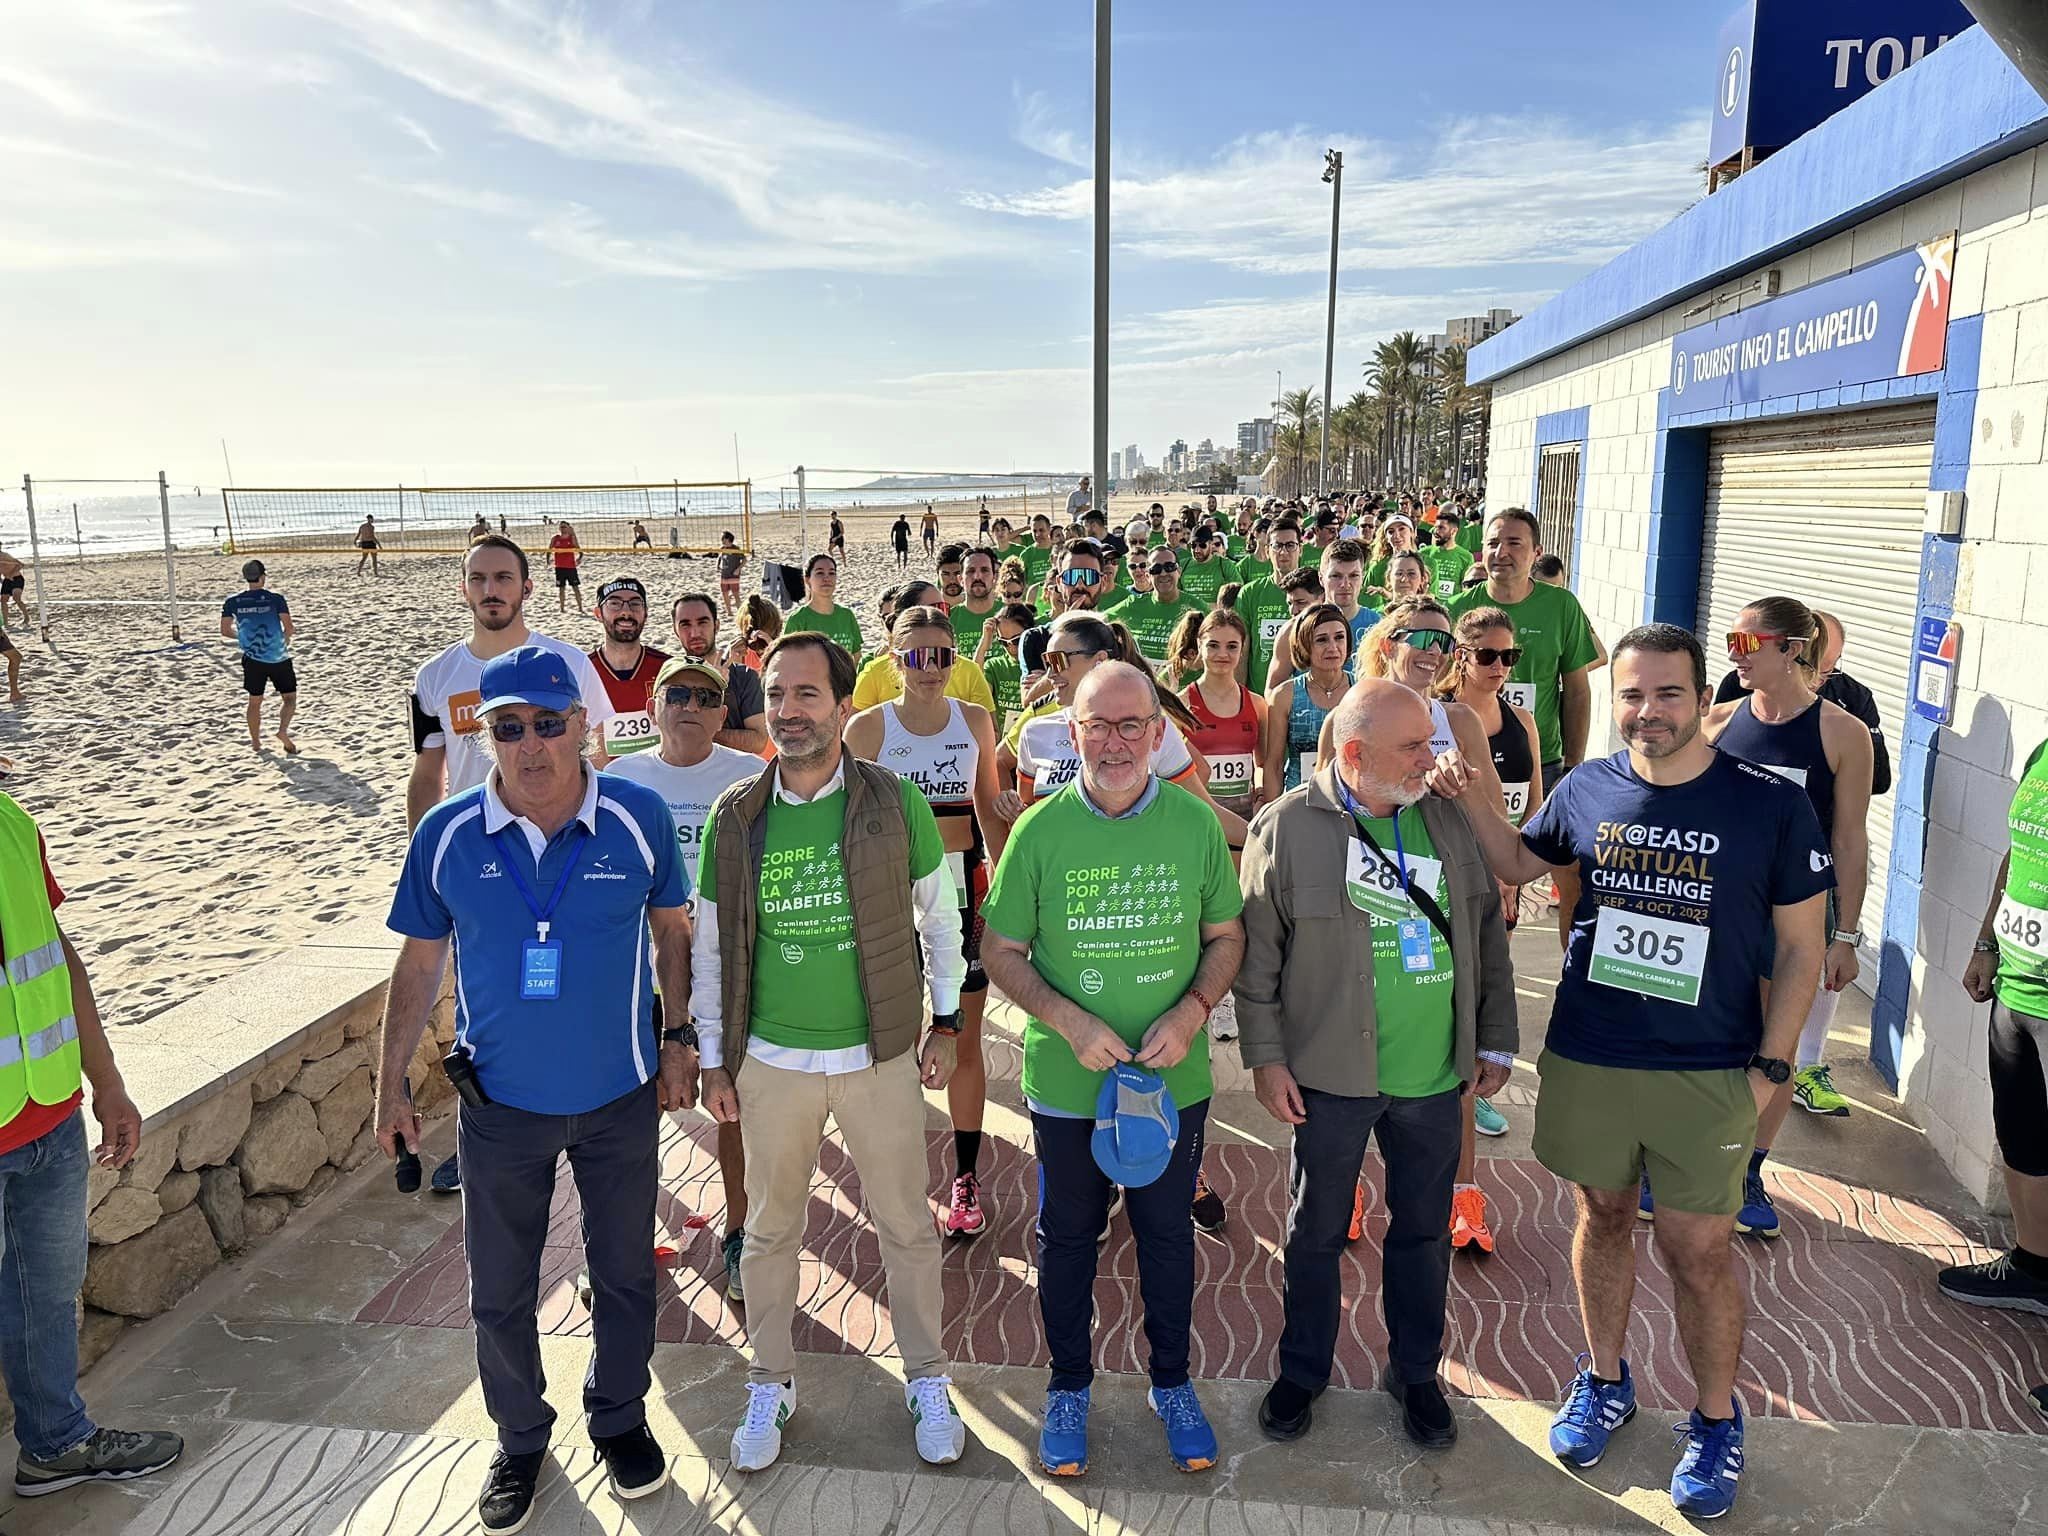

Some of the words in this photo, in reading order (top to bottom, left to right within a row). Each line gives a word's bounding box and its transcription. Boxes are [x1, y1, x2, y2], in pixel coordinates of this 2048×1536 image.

[1693, 342, 1738, 383] TOURIST
[1740, 332, 1772, 371] INFO
[1776, 327, 1791, 363] EL
[1794, 300, 1878, 358] CAMPELLO
[603, 581, 638, 596] INVICTUS
[614, 718, 651, 737] 239
[1213, 762, 1245, 779] 193
[1737, 763, 1773, 780] CRAFT
[1596, 822, 1720, 855] 5K@EASD
[761, 846, 815, 867] CORRE
[1594, 844, 1714, 882] VIRTUAL
[760, 867, 794, 884] POR
[1065, 866, 1120, 883] CORRE
[761, 885, 781, 899] LA
[1066, 884, 1100, 899] POR
[1591, 869, 1713, 901] CHALLENGE
[764, 891, 843, 914] DIABETES
[1066, 901, 1086, 915] LA
[1604, 896, 1626, 908] SEP
[1636, 901, 1645, 911] 4
[1647, 902, 1676, 917] OCT,
[1680, 906, 1709, 921] 2023
[777, 919, 819, 928] Caminata
[790, 926, 822, 936] Mundial
[838, 923, 848, 931] la
[1067, 915, 1144, 931] DIABETES
[2001, 908, 2042, 948] 348
[1077, 941, 1120, 949] Caminata
[1130, 938, 1164, 948] Carrera
[1613, 925, 1686, 966] 305
[1088, 950, 1122, 959] Mundial
[1125, 949, 1135, 958] de
[1137, 949, 1146, 957] la
[1136, 968, 1175, 984] Dexcom
[1611, 966, 1645, 979] CAMINATA
[527, 980, 556, 988] STAFF
